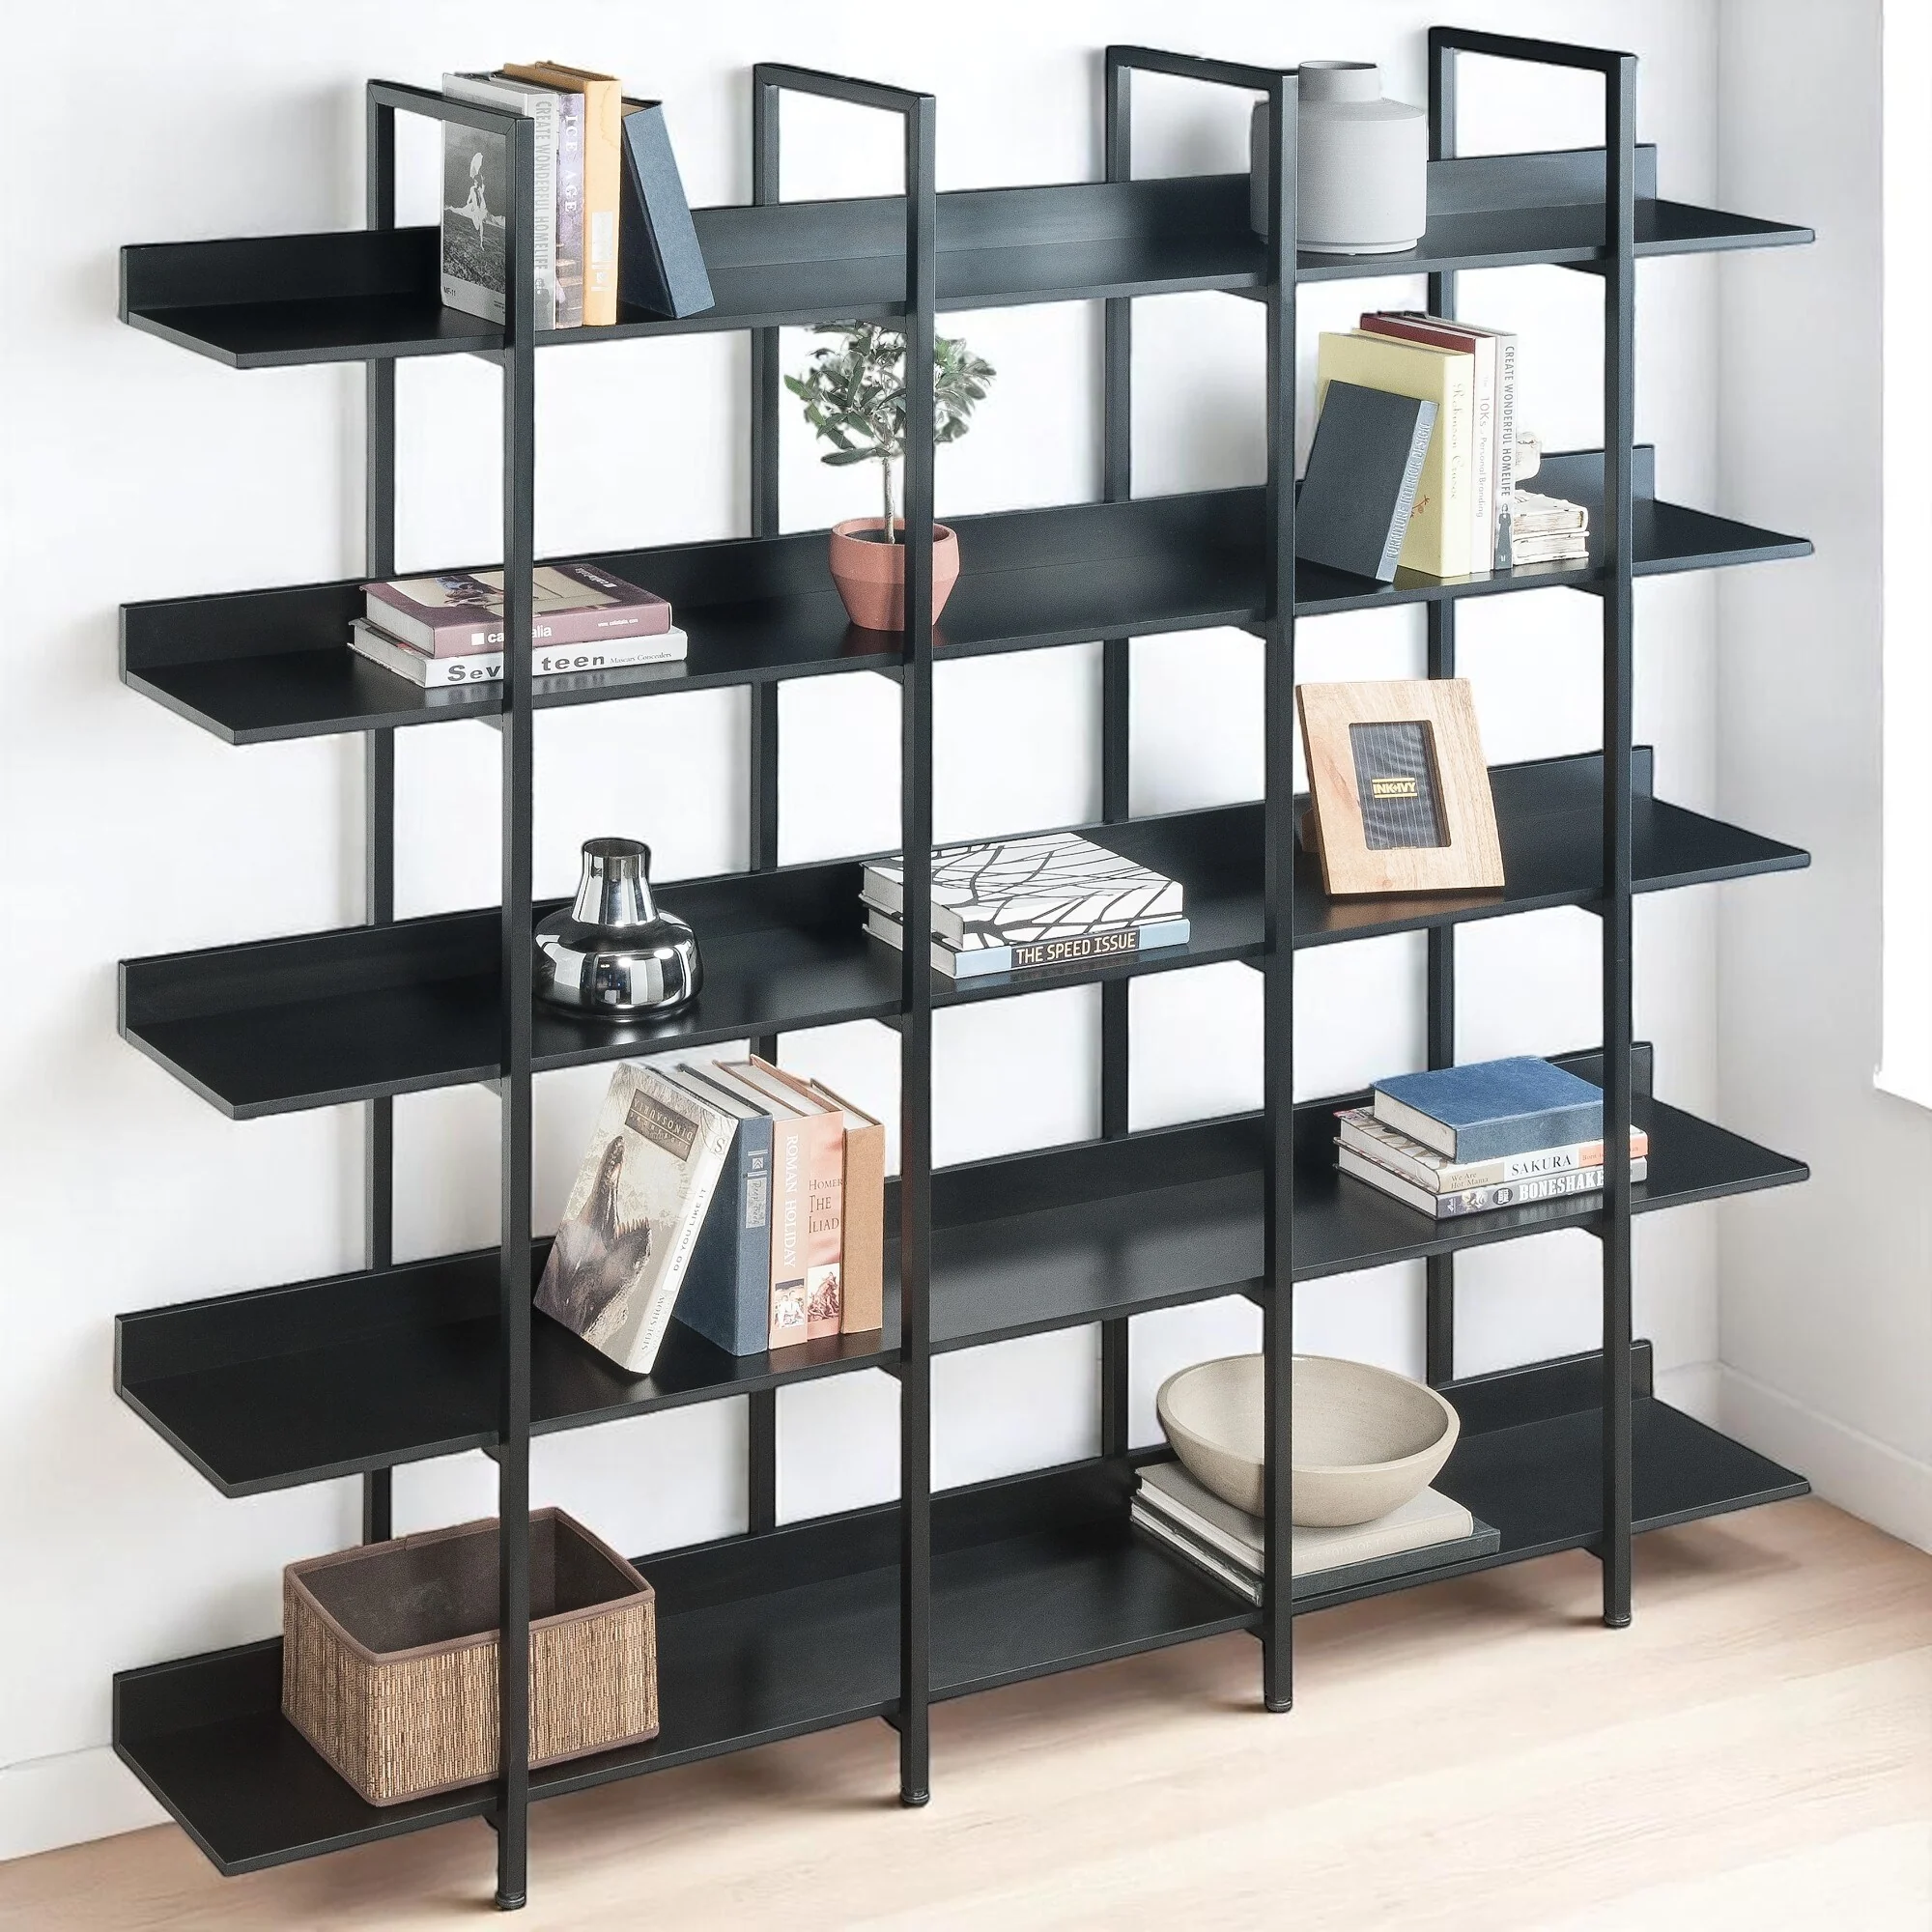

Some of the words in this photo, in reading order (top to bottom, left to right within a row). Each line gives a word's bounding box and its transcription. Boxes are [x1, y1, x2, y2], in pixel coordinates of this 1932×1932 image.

[535, 100, 552, 140] CREATE
[564, 115, 580, 152] ICE
[534, 143, 551, 213] WONDERFUL
[563, 170, 579, 213] AGE
[534, 216, 550, 270] HOMELIFE
[1504, 346, 1515, 381] CREATE
[1502, 384, 1514, 445] WONDERFUL
[1479, 437, 1488, 475] Personal
[1501, 448, 1512, 497] HOMELIFE
[1386, 503, 1409, 560] FURNITURE
[1400, 460, 1421, 503] INTERIOR
[1411, 422, 1430, 459] DESIGN
[1476, 476, 1487, 518] Branding
[447, 655, 605, 682] Sevteen
[1016, 946, 1044, 965] THE
[1046, 939, 1091, 961] SPEED
[1093, 931, 1137, 954] ISSUE
[633, 1097, 694, 1141] DINOSAURIA
[786, 1133, 799, 1194] ROMAN
[1511, 1154, 1572, 1177] SAKURA
[809, 1179, 843, 1191] HOMER
[809, 1194, 832, 1213] THE
[1519, 1169, 1604, 1202] BONESHAKE
[783, 1199, 797, 1268] HOLIDAY
[808, 1215, 839, 1234] ILIAD
[673, 1255, 683, 1271] DO
[681, 1229, 692, 1251] YOU
[641, 1294, 666, 1351] SIDESHOW
